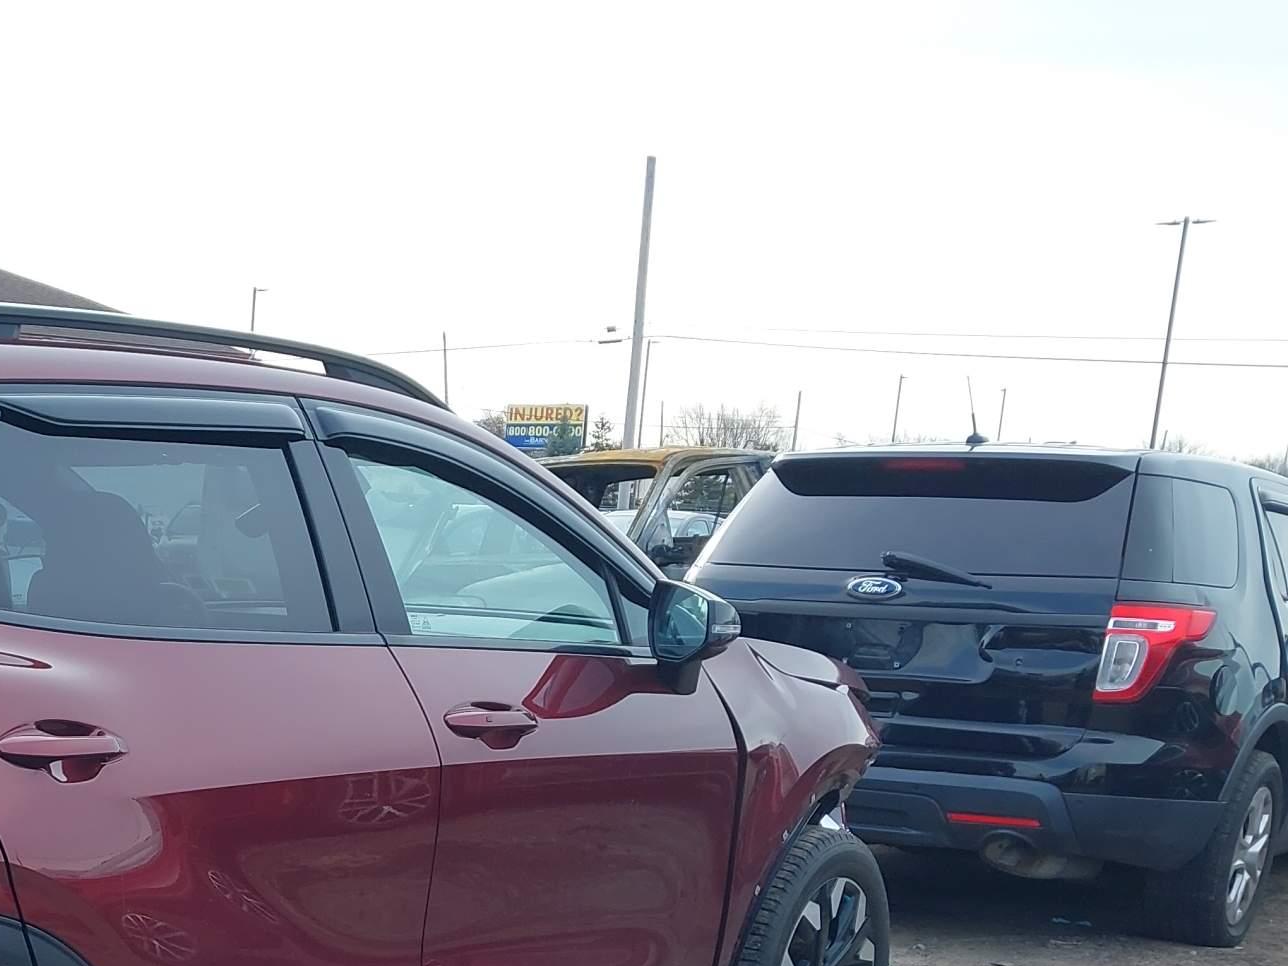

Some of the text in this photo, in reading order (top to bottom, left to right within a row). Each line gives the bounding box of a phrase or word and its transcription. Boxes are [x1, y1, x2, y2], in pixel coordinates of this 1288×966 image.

[509, 406, 584, 422] INJURED?
[528, 425, 582, 437] 800-000
[858, 580, 889, 593] Ford
